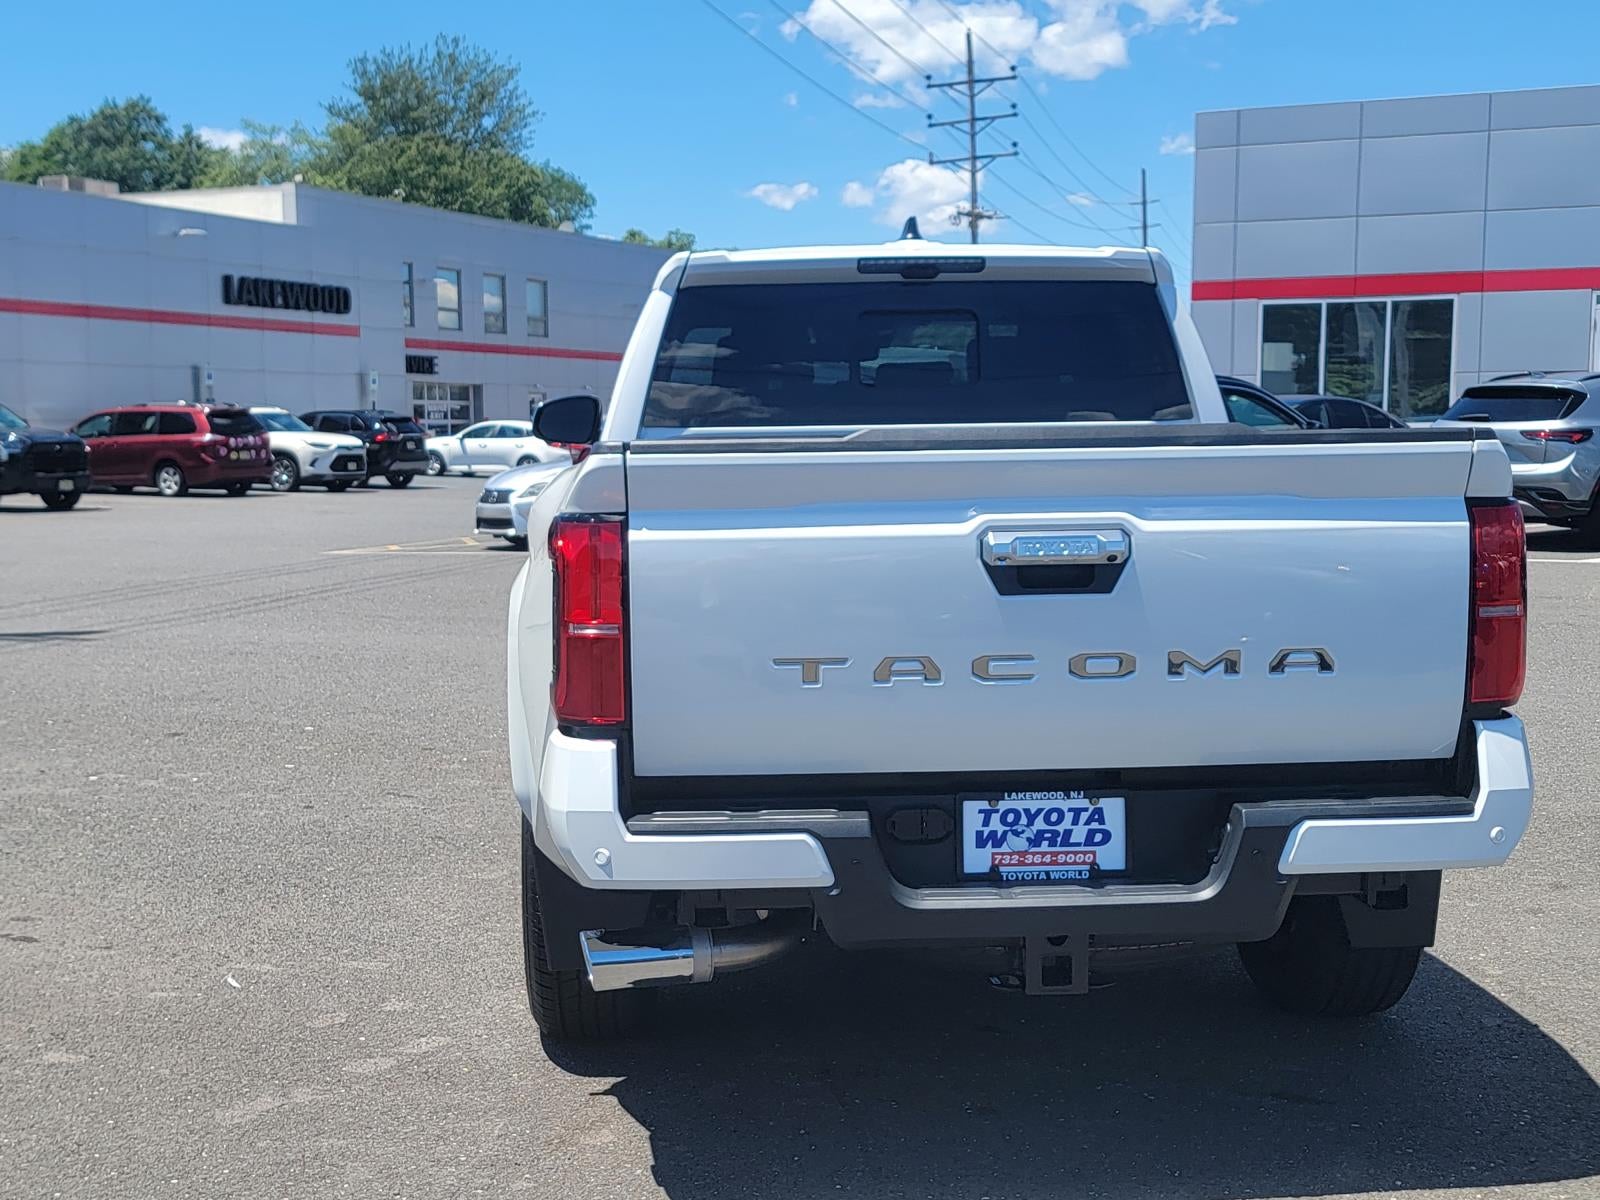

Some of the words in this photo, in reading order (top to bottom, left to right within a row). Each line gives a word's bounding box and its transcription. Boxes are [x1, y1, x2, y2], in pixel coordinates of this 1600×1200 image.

[221, 274, 352, 314] LAKEWOOD
[1022, 540, 1097, 556] TOYOTA
[771, 647, 1336, 688] TACOMA
[1070, 790, 1085, 799] NJ
[978, 807, 1106, 827] TOYOTA
[975, 826, 1112, 851] WORLD
[994, 853, 1094, 864] 732-364-9000
[1001, 871, 1047, 881] TOYOTA
[1050, 870, 1089, 880] WORLD
